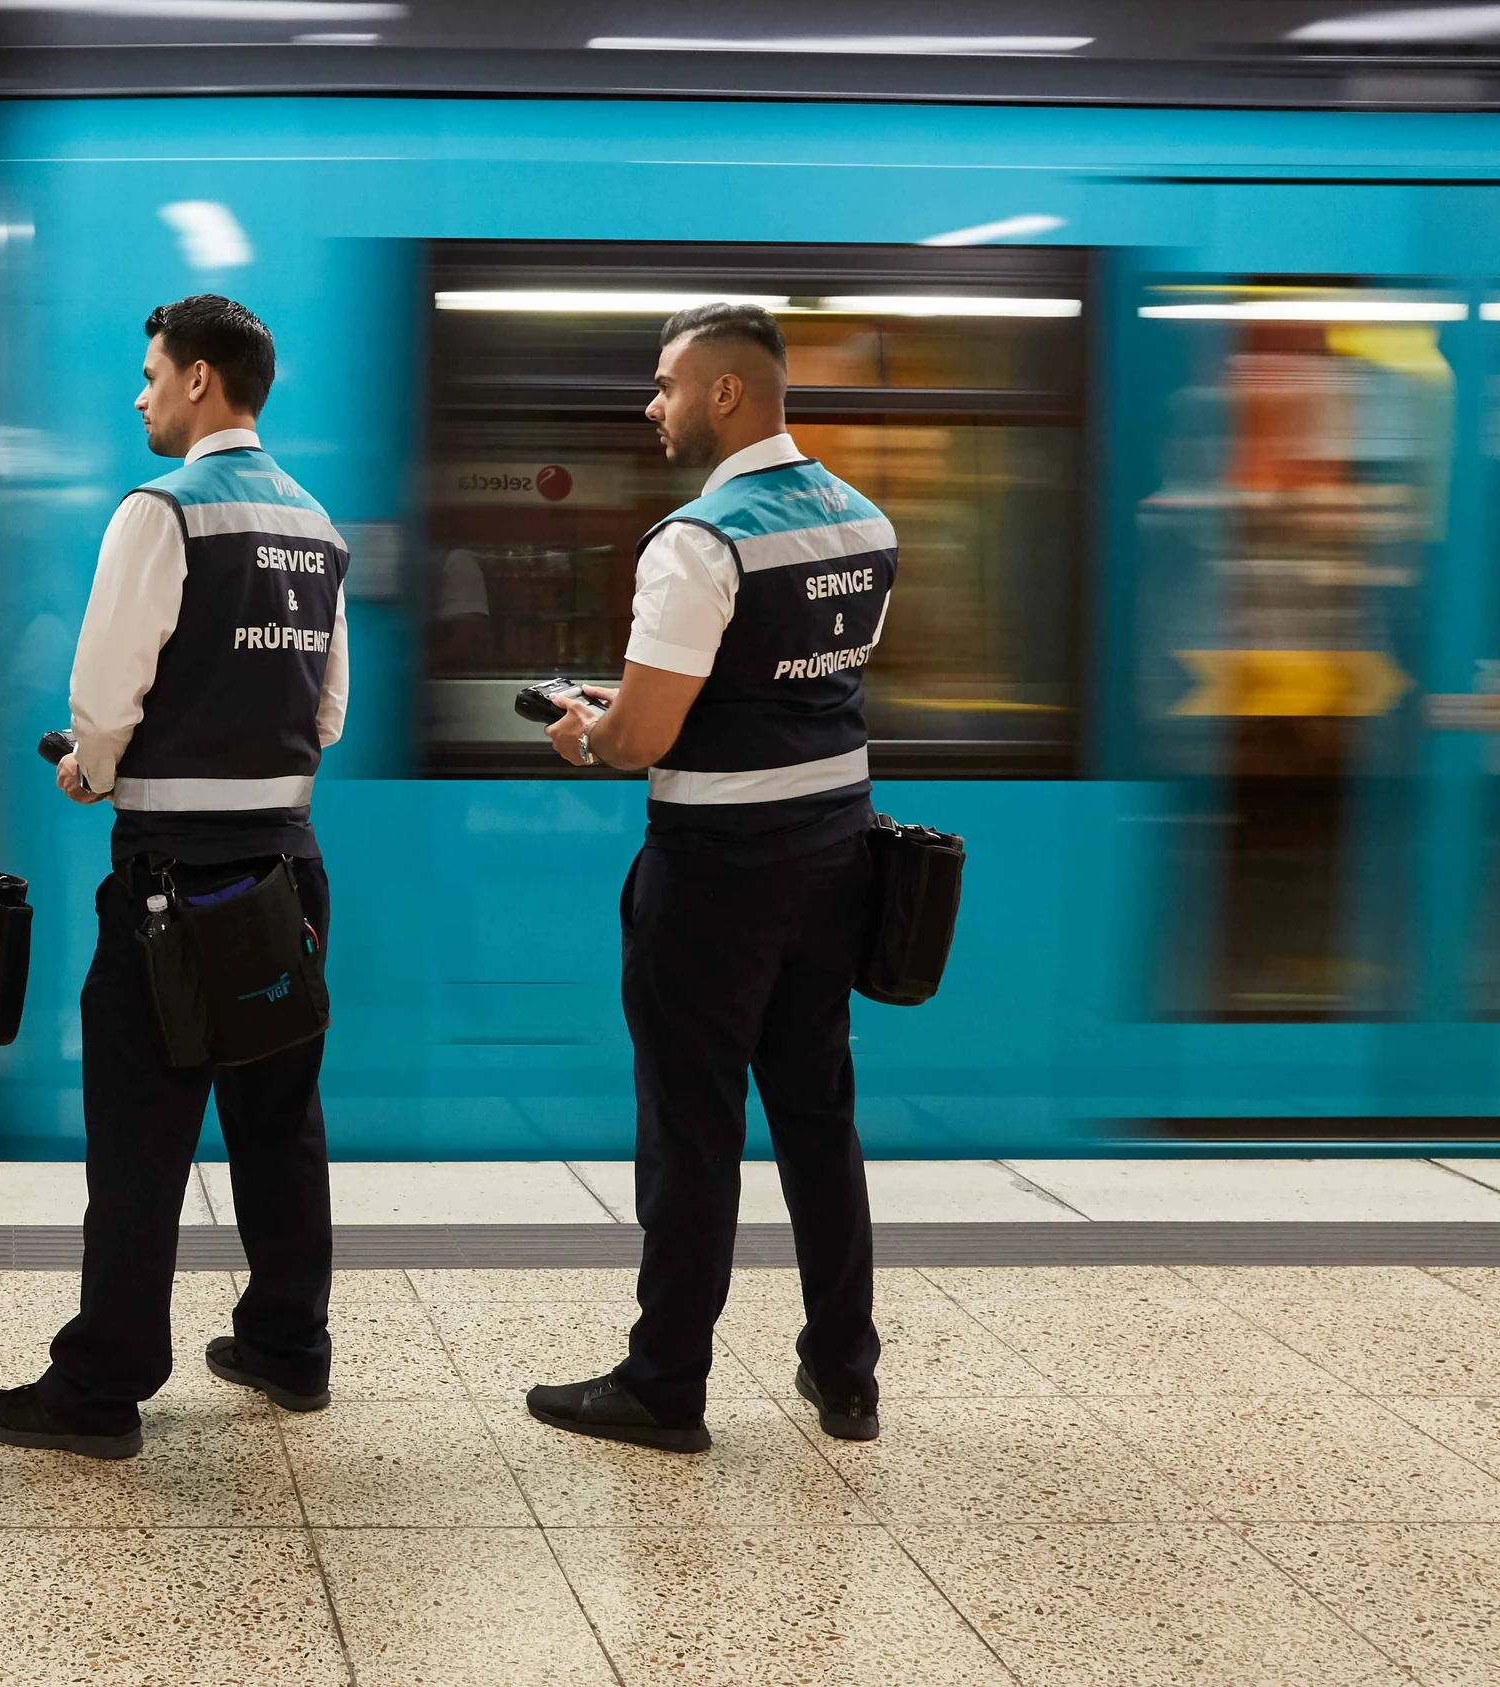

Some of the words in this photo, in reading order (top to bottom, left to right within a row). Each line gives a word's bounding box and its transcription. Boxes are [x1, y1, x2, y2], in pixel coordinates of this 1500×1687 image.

[256, 546, 325, 575] SERVICE
[806, 567, 874, 600] SERVICE
[287, 589, 299, 611] &
[833, 612, 844, 636] &
[773, 643, 873, 680] PRÜFDIENST
